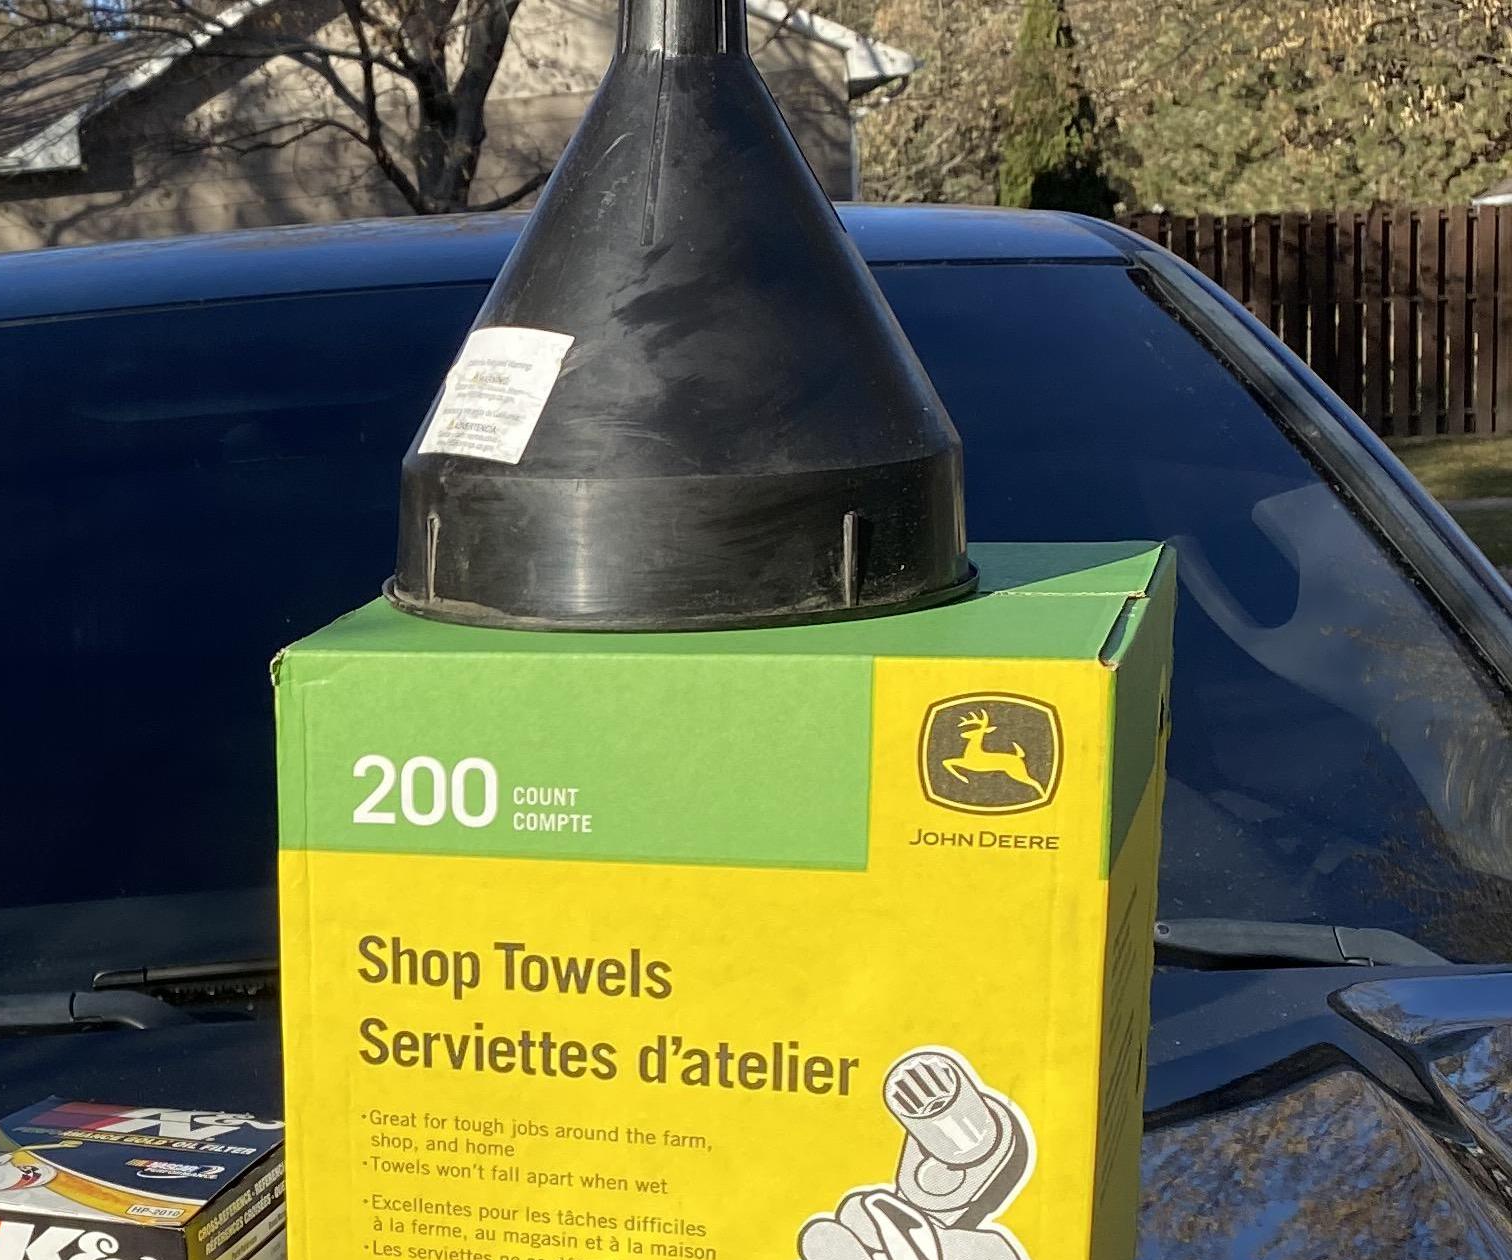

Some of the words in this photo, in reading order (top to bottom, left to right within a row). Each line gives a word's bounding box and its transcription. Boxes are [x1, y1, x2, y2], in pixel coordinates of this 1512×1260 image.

[353, 754, 497, 828] 200
[513, 787, 579, 807] COUNT
[513, 812, 592, 832] COMPTE
[909, 828, 974, 847] JOHN
[979, 831, 1060, 850] DEERE
[357, 935, 481, 1000] Shop
[494, 941, 673, 1000] Towels
[357, 1018, 618, 1080] Serviettes
[172, 1138, 202, 1149] OIL
[202, 1142, 256, 1155] FILTER
[371, 1133, 419, 1153] shop,
[426, 1138, 458, 1153] and
[466, 1139, 515, 1157] home
[424, 1113, 447, 1129] for
[455, 1116, 504, 1136] tough
[511, 1119, 549, 1138] jobs
[556, 1126, 619, 1142] around
[626, 1128, 656, 1144] the
[663, 1130, 712, 1152] farm,
[491, 1166, 519, 1182] fall
[526, 1171, 573, 1187] apart
[580, 1173, 628, 1191] when
[635, 1179, 668, 1194] wet
[479, 1206, 518, 1221] pour
[525, 1206, 551, 1224] les
[558, 1210, 617, 1229] tâches
[624, 1216, 707, 1237] difficiles
[373, 1216, 383, 1231] à
[390, 1218, 404, 1233] la
[412, 1219, 467, 1241] ferme,
[475, 1228, 495, 1241] au
[503, 1230, 578, 1249] magasin
[585, 1235, 603, 1250] et
[609, 1236, 619, 1252] à
[628, 1238, 643, 1254] la
[651, 1242, 716, 1260] maison
